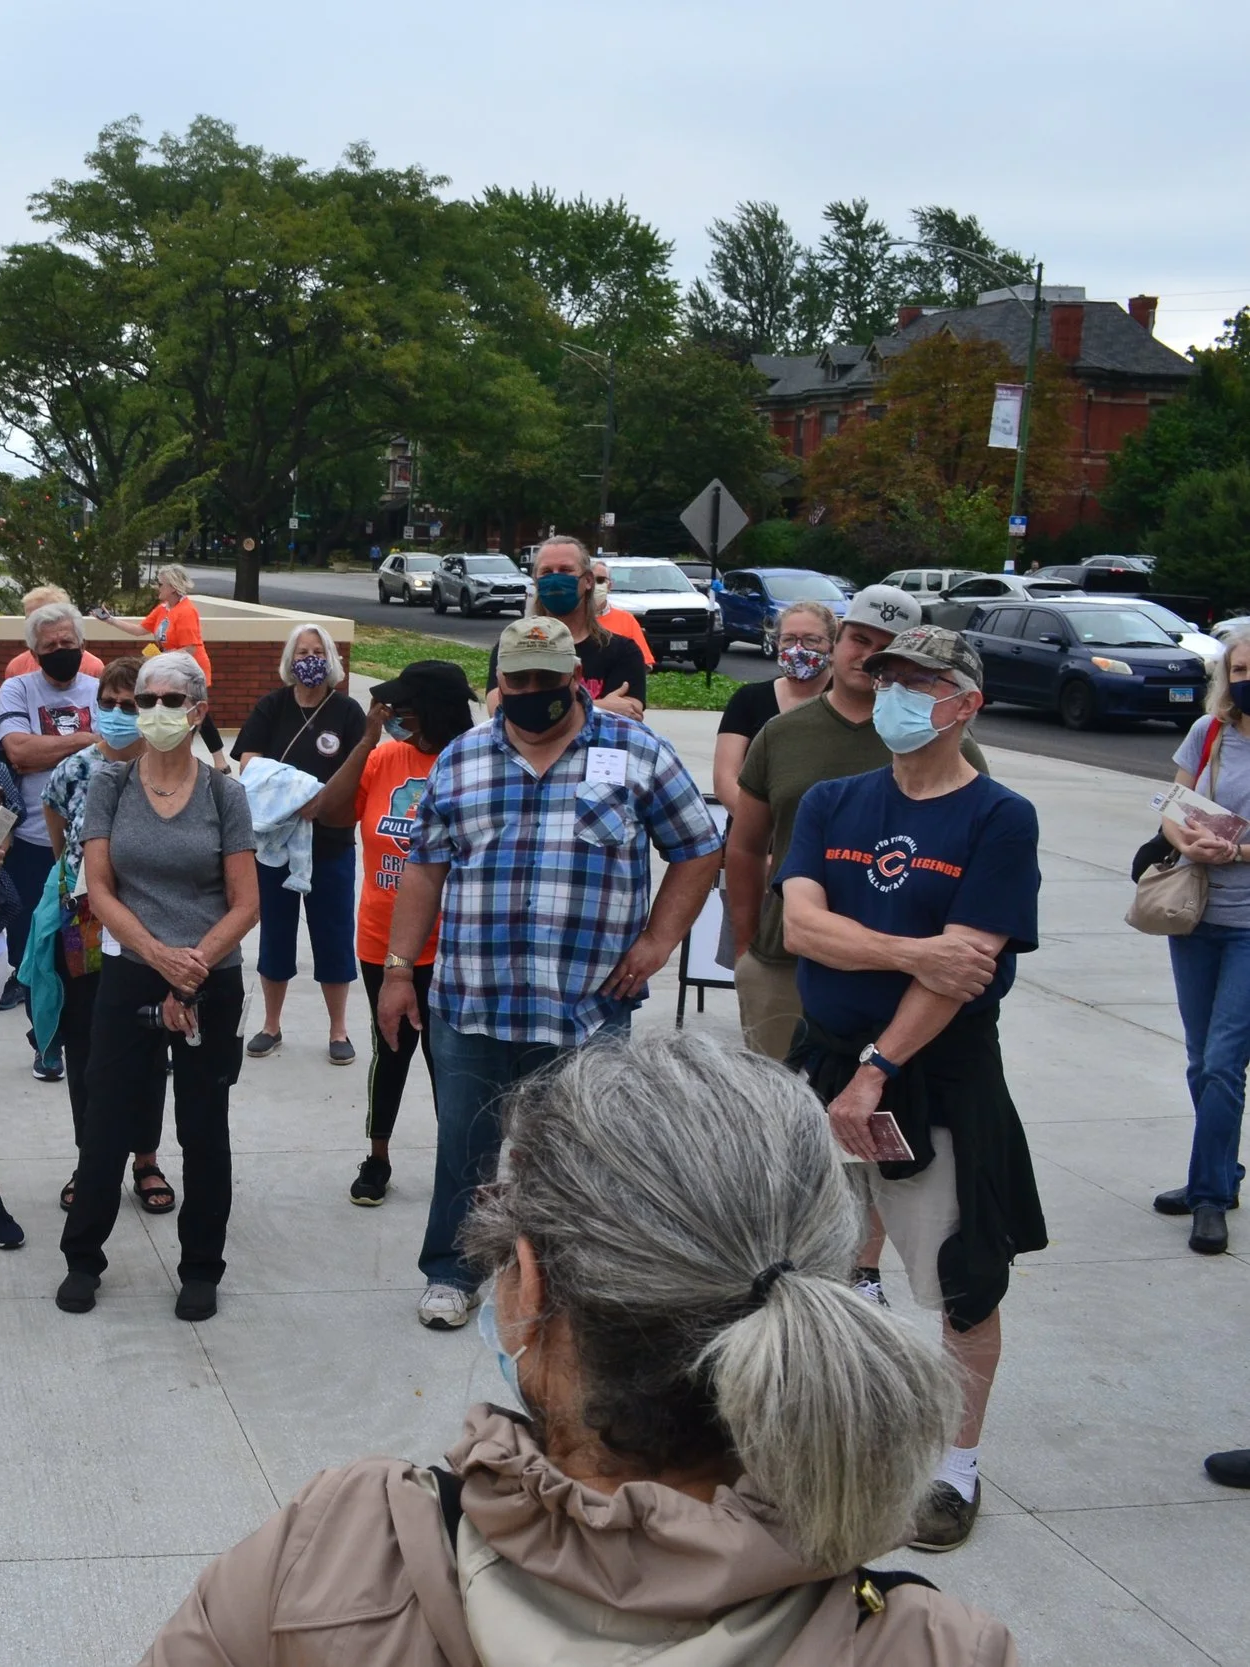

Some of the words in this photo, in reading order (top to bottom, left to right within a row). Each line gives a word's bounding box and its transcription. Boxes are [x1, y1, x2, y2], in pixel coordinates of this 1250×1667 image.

[381, 821, 413, 834] PULL
[891, 835, 918, 854] FOOTBALL
[825, 848, 873, 865] BEARS
[911, 857, 962, 878] LEGENDS
[867, 869, 879, 888] HALL
[890, 871, 909, 890] FAME
